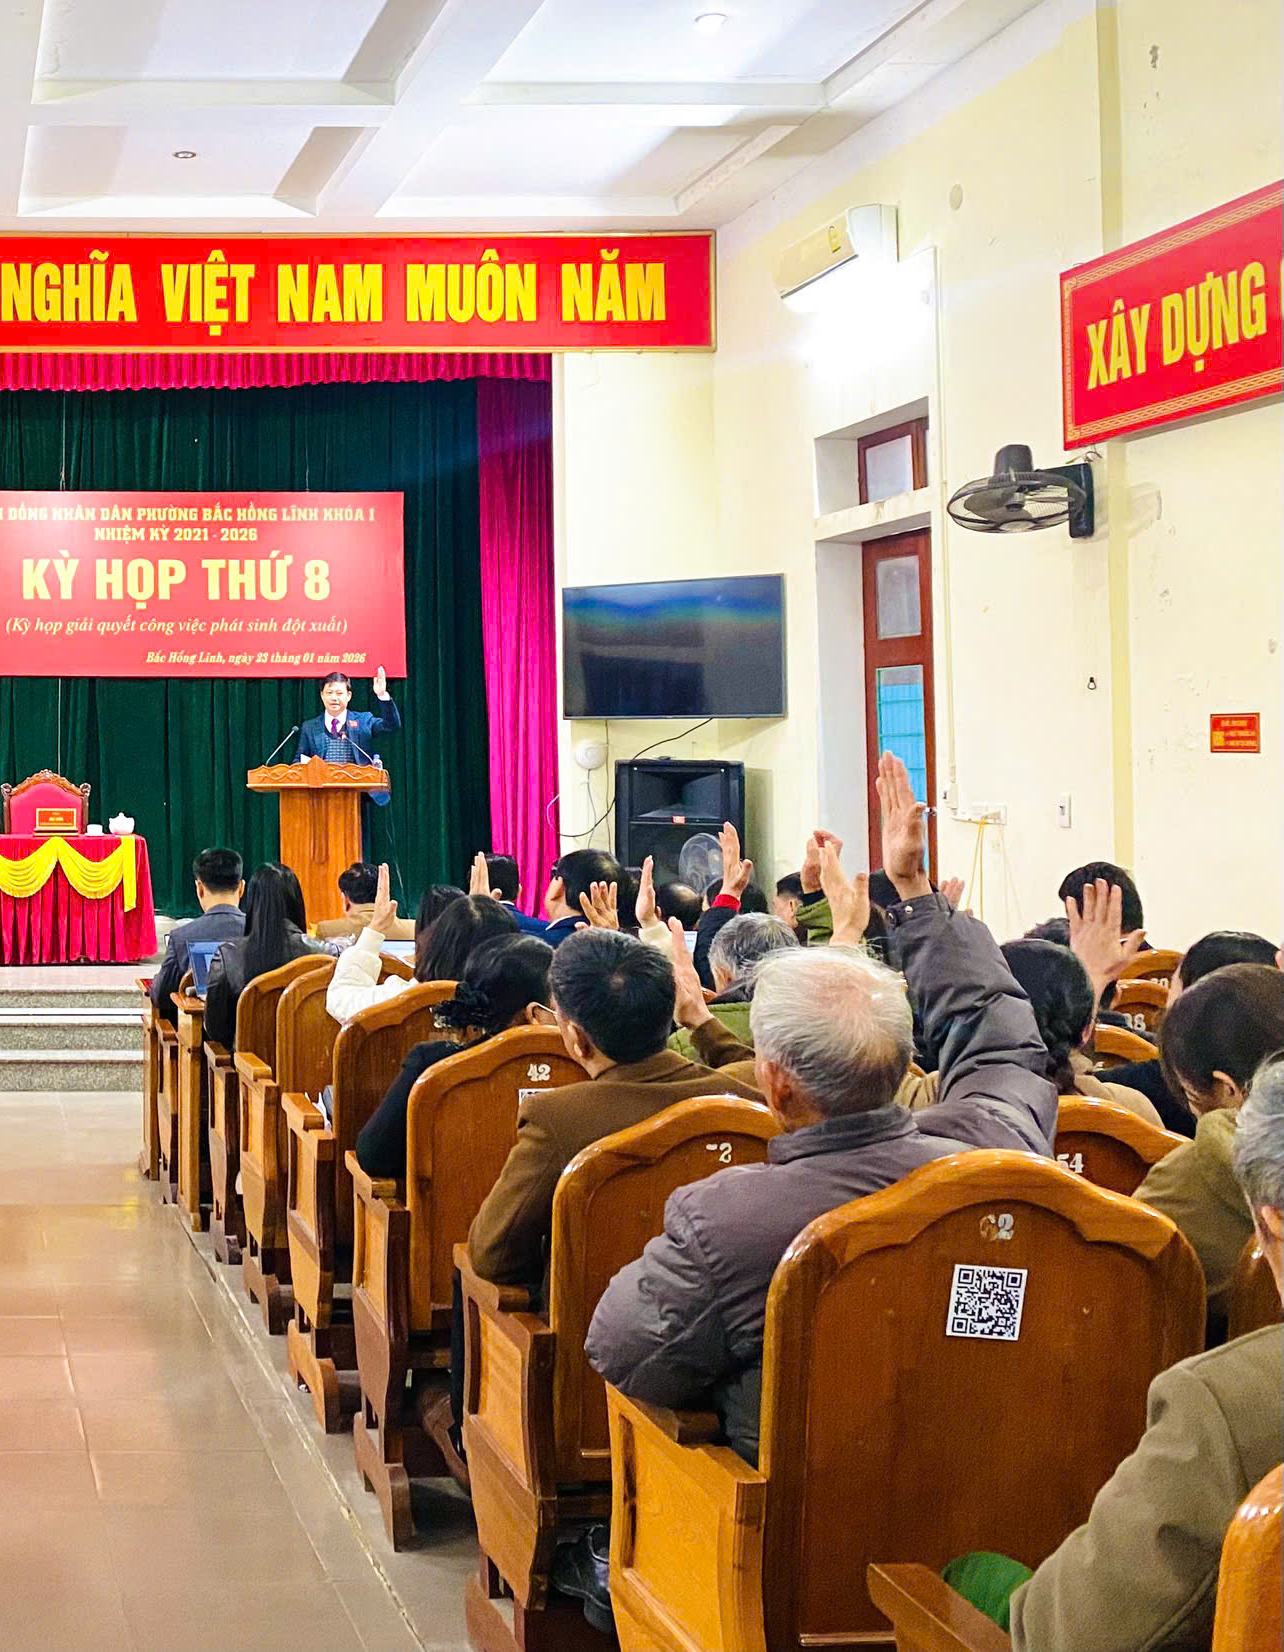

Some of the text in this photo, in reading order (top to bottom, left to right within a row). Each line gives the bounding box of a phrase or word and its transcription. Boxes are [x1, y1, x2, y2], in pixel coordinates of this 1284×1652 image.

[1, 250, 137, 322] NGHĨA
[161, 249, 256, 336] VIỆT
[278, 263, 383, 322] NAM
[406, 250, 537, 322] MUÔN
[562, 249, 666, 321] NĂM
[1087, 298, 1151, 390] XÂY
[1161, 261, 1267, 373] DỰNG
[52, 505, 95, 521] NHÂN
[100, 504, 132, 521] DÂN
[137, 504, 198, 521] PHƯỜNG
[202, 502, 233, 521] BẮC
[237, 502, 277, 521] HỒNG
[282, 505, 318, 521] LĨNH
[323, 504, 364, 521] KHÓA
[95, 525, 145, 544] NHIỆM
[150, 524, 170, 541] KỲ
[174, 528, 209, 541] 2021
[220, 528, 258, 542] 2026
[22, 550, 330, 610] KỲ HỌP THỨ 8
[6, 614, 348, 635] (Kỳ họp giải quyết công việc phát sinh đột xuất)
[228, 652, 253, 665] ngày
[270, 651, 300, 665] tháng
[303, 652, 314, 663] 01
[317, 652, 340, 663] năm
[342, 652, 366, 663] 2026
[527, 1063, 550, 1081] 42
